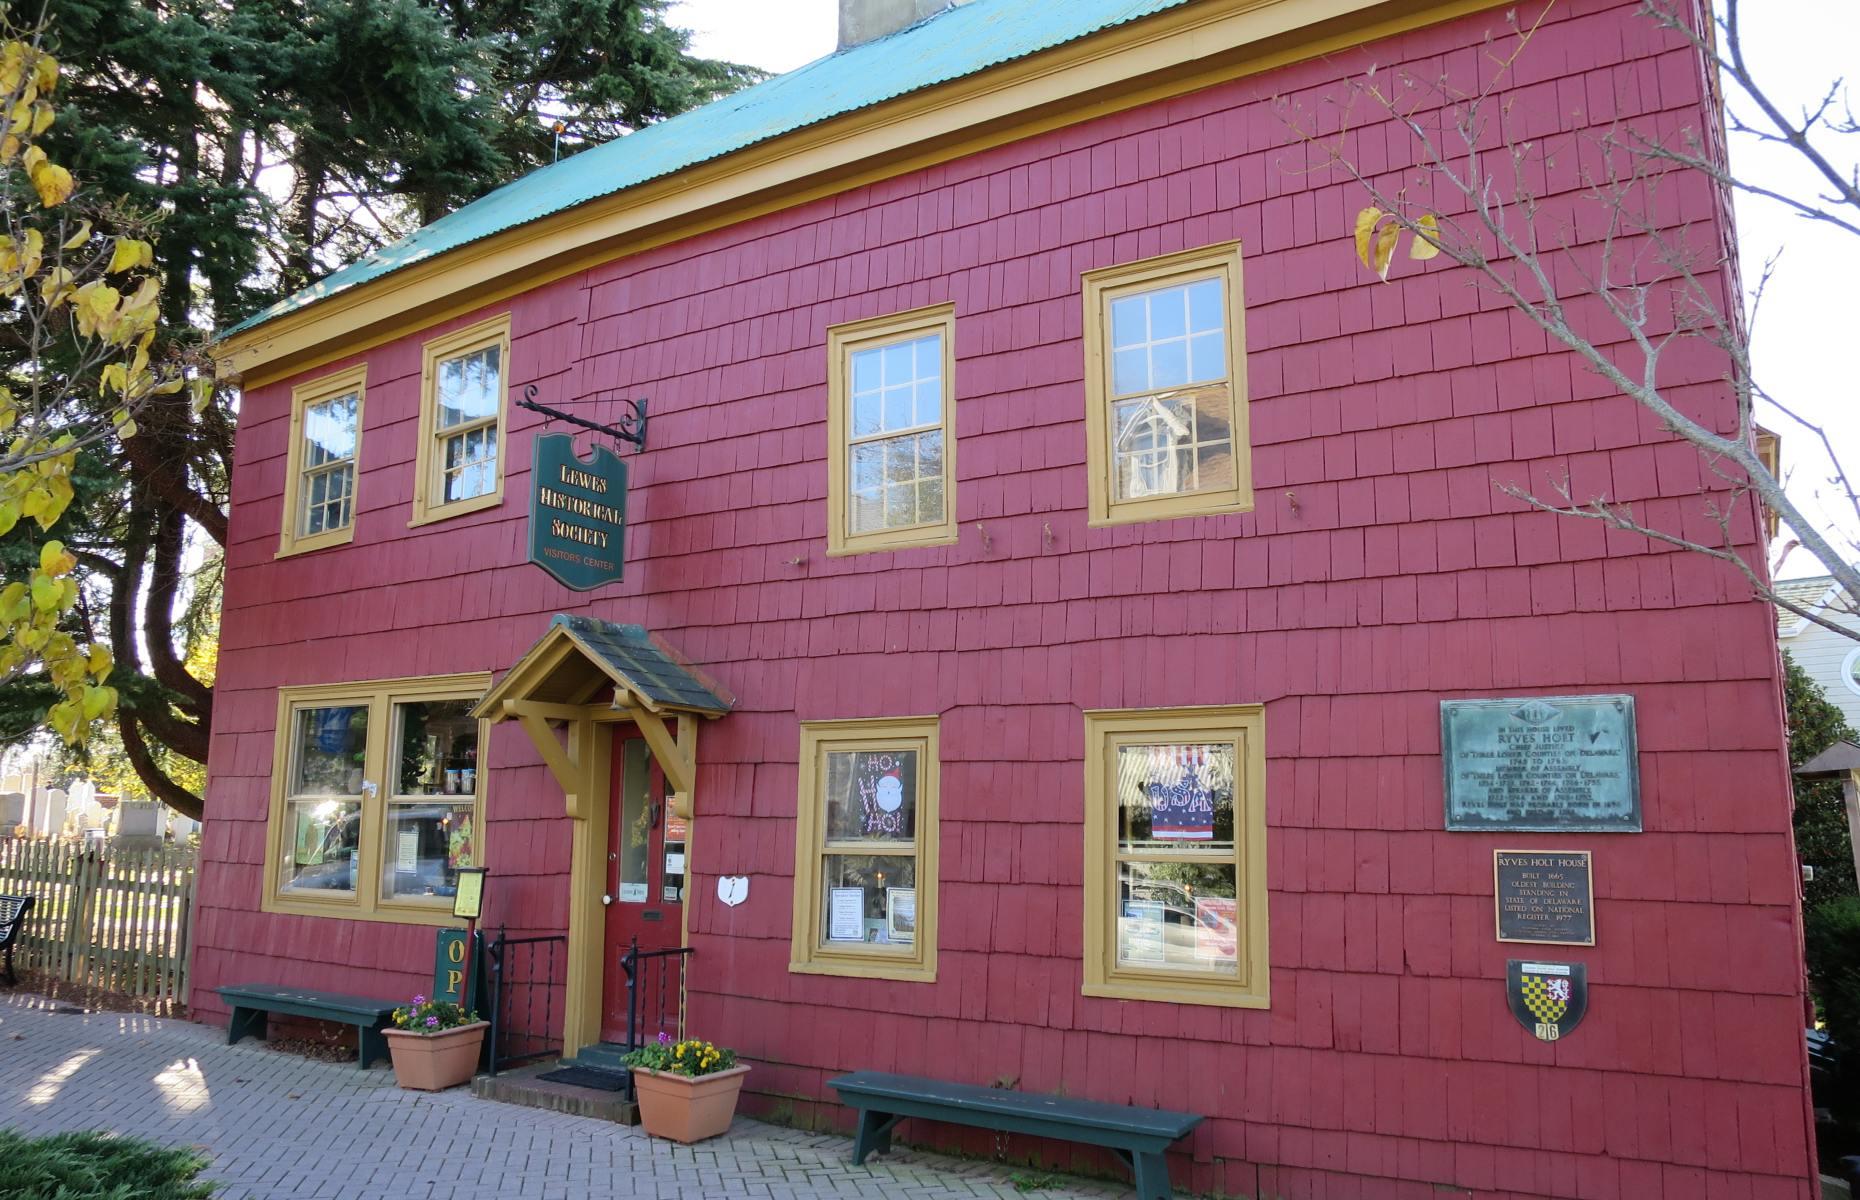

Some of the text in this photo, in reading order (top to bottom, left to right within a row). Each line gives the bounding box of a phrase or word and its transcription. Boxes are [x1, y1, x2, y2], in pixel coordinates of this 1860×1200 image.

[560, 464, 607, 494] LEWES
[540, 487, 622, 525] HISTORICAL
[552, 518, 608, 548] SOCIETY
[544, 547, 615, 571] VISITORS CENTER
[1498, 733, 1575, 744] RYVES HOLT
[868, 754, 892, 771] HO
[1151, 779, 1212, 812] USA
[1499, 858, 1587, 867] RYVES HOLT HOUSE
[1542, 881, 1575, 889] BUILDING
[447, 939, 466, 1009] OP
